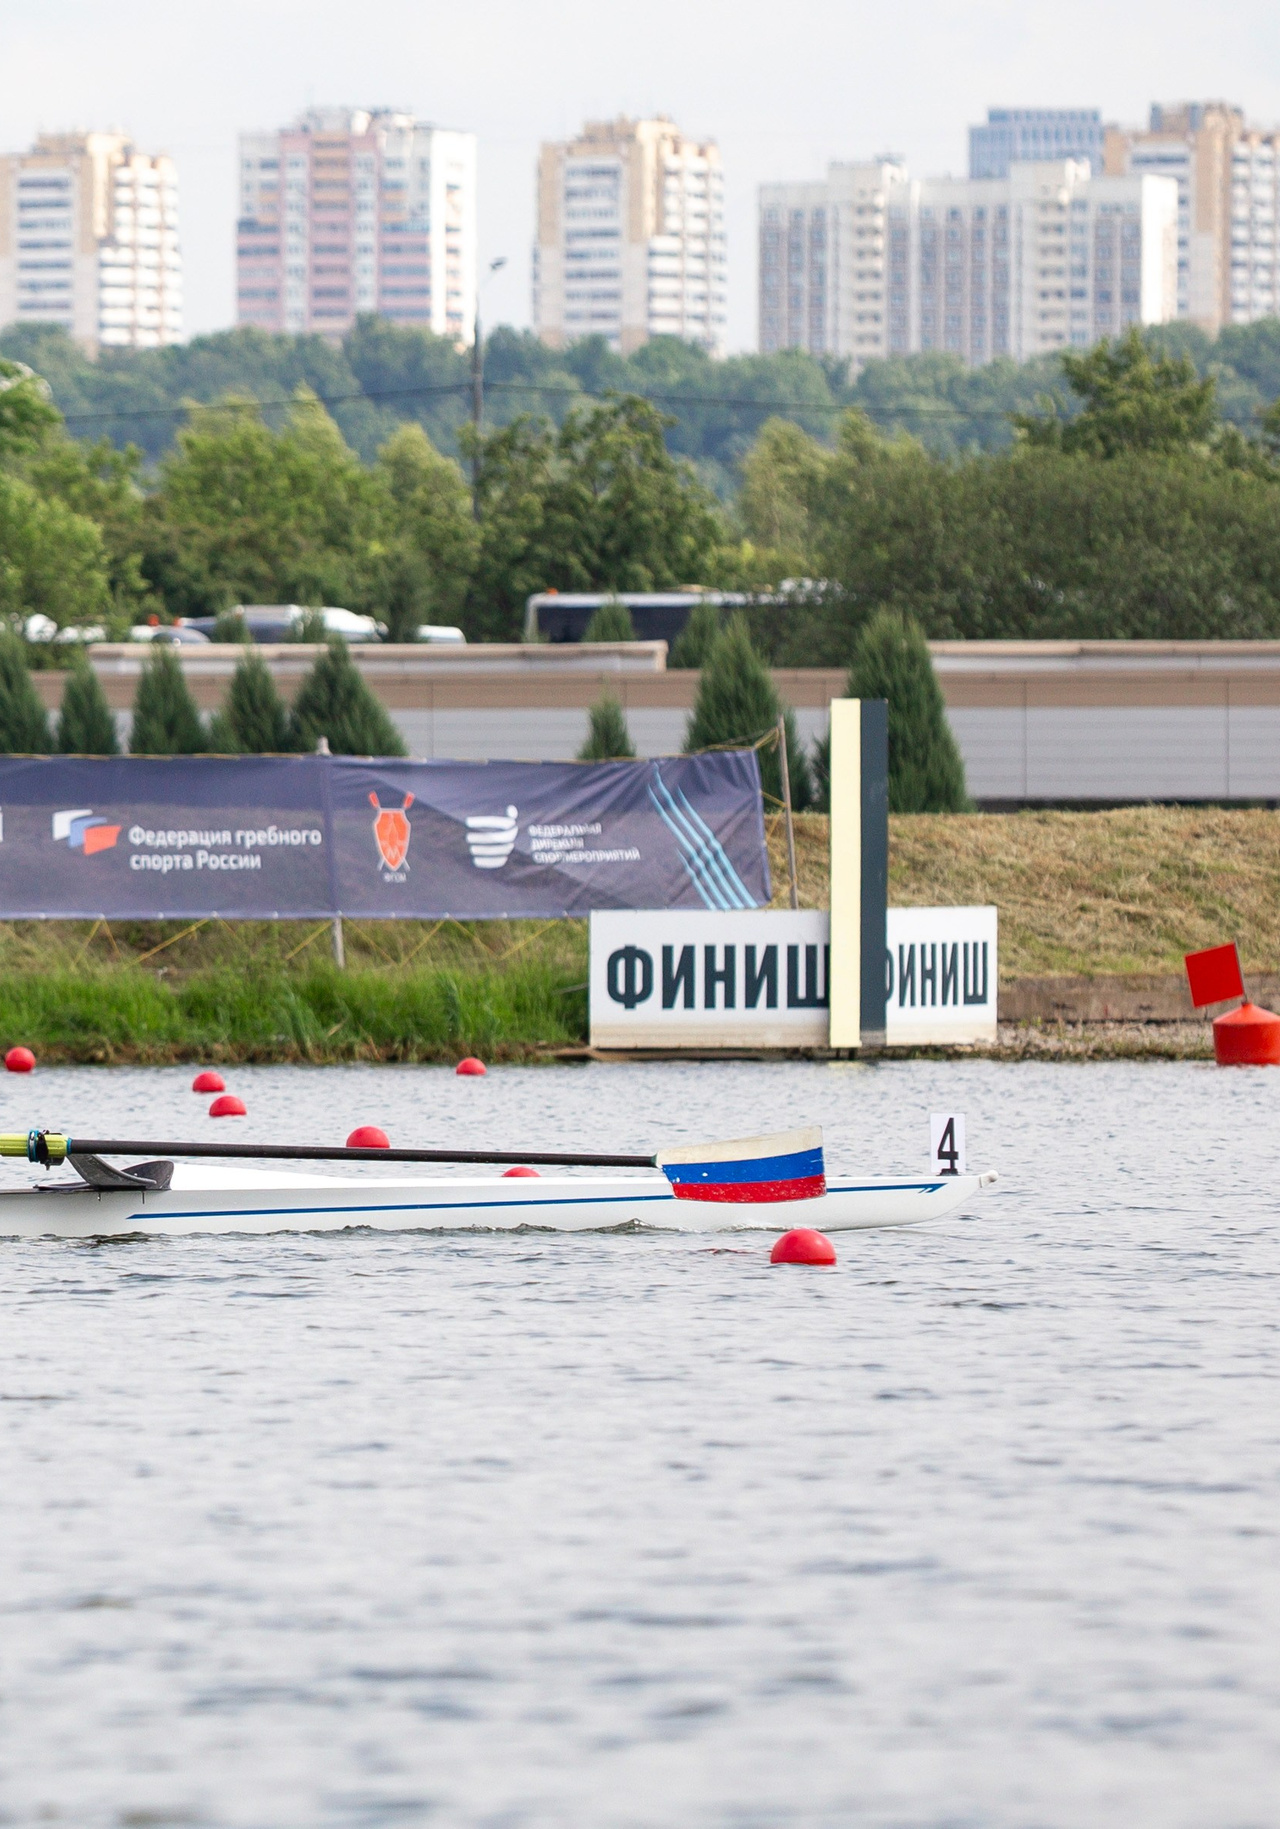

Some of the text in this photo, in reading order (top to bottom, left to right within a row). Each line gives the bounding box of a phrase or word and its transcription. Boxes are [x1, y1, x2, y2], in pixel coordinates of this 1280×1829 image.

[128, 825, 322, 849] Федерация гребного
[129, 850, 262, 874] спорта России
[607, 943, 831, 1009] ФИНИШ
[936, 1117, 959, 1169] 4
